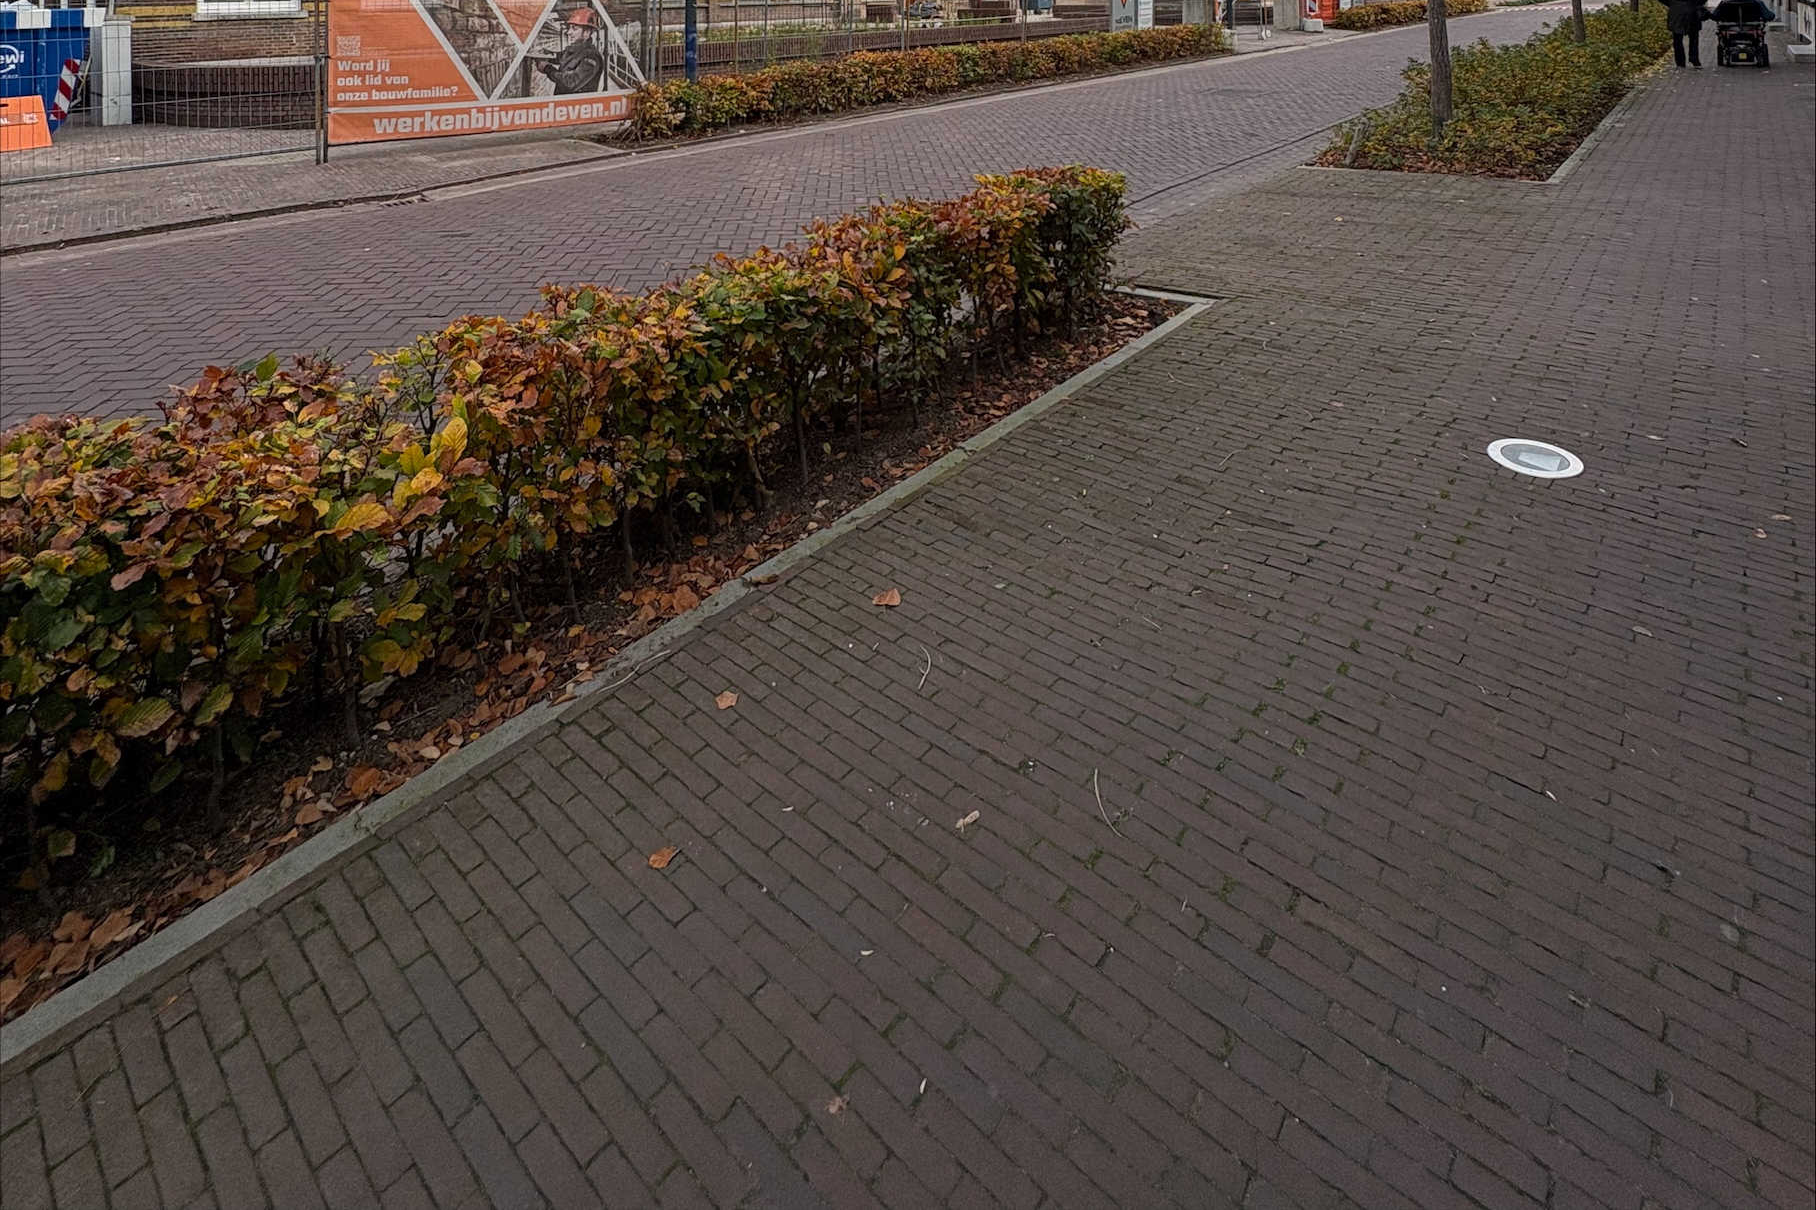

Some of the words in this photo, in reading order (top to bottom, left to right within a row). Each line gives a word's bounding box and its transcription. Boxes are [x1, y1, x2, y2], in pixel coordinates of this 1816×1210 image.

[337, 59, 374, 71] Word
[376, 59, 390, 73] jij
[337, 74, 362, 87] ook
[365, 74, 382, 86] lid
[385, 75, 409, 85] van
[336, 91, 369, 101] onze
[371, 85, 459, 100] bouwfamilie?
[373, 96, 628, 134] werkenbijvandeven.nl
